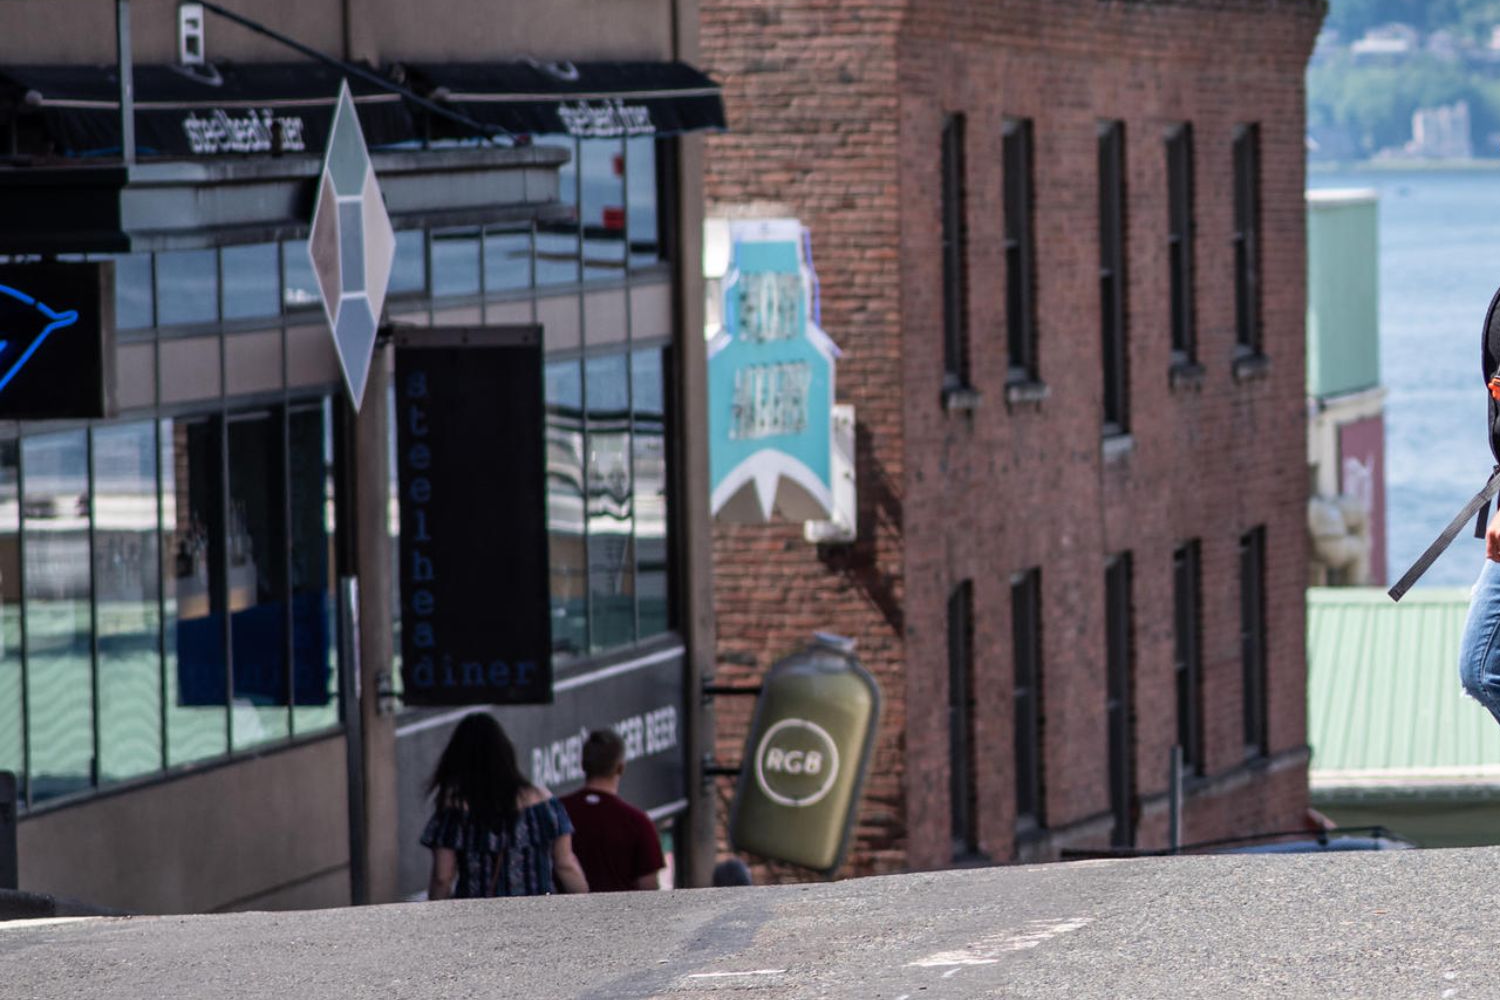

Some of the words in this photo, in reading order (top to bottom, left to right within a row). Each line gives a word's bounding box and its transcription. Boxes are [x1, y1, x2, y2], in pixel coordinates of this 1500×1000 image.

[412, 656, 537, 689] diner
[645, 705, 677, 755] BEER
[766, 747, 822, 776] RGB
